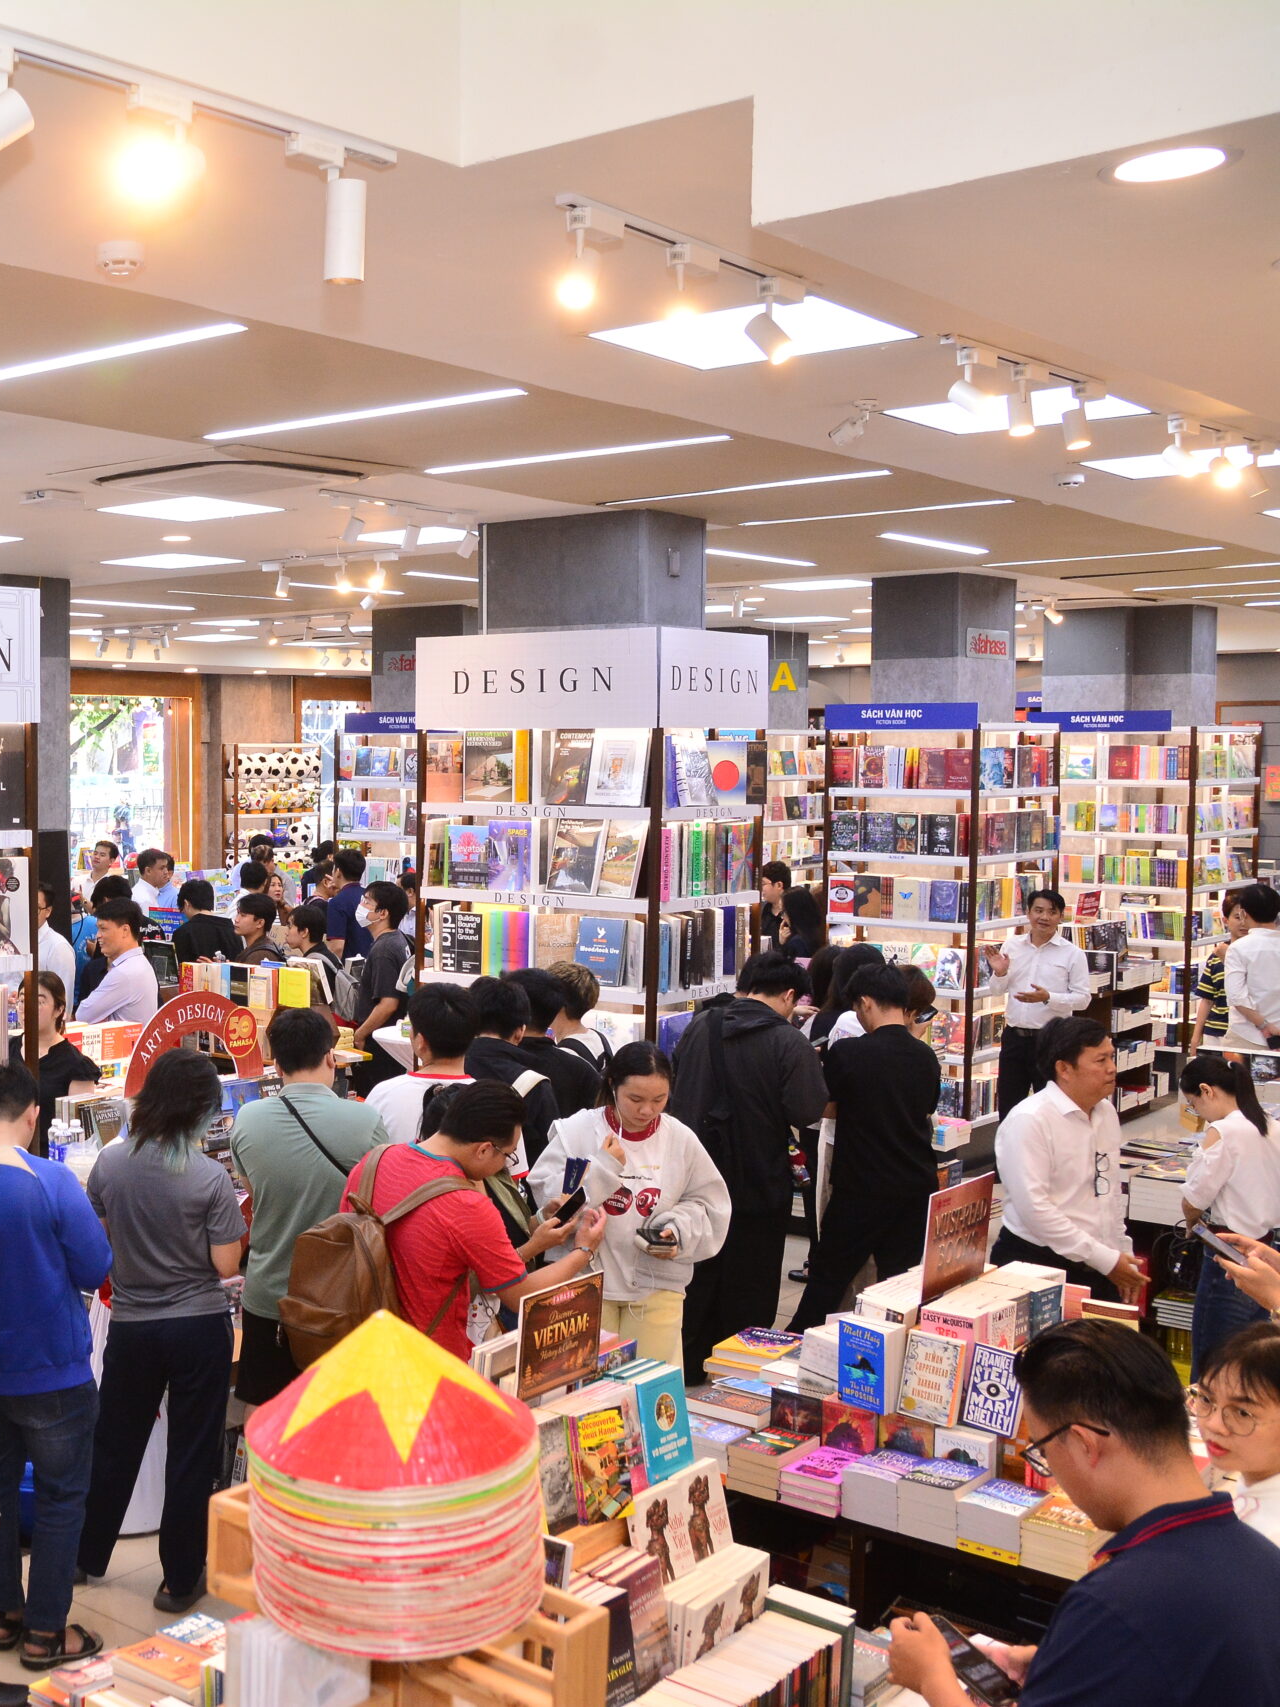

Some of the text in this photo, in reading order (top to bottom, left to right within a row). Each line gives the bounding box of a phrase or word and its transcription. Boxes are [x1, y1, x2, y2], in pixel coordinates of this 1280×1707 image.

[977, 633, 1007, 656] fahasa
[453, 666, 614, 695] DESIGN
[671, 665, 759, 694] DESIGN
[771, 662, 798, 692] A
[379, 716, 408, 724] SÁCH VĂN
[861, 708, 923, 719] SÁCH VĂN HỌC
[1071, 715, 1124, 723] SÁCH VĂN HỌC
[496, 806, 567, 817] DESIGN
[696, 808, 733, 817] DESIGN
[508, 829, 527, 837] SPACE
[494, 893, 565, 907] DESIGN
[694, 897, 730, 908] DESIGN
[458, 915, 481, 923] Building
[692, 985, 729, 999] DESIGN
[140, 1029, 164, 1064] ART
[165, 1018, 175, 1032] &
[177, 1003, 225, 1025] DESIGN
[228, 1015, 254, 1040] 50
[230, 1038, 253, 1049] FAHASA
[922, 1314, 973, 1329] CASEY McQUISTON
[533, 1313, 590, 1350] VIETNAM:
[752, 1330, 794, 1341] IMMUNE
[842, 1323, 881, 1347] Matt Haig
[936, 1327, 958, 1338] RED
[539, 1348, 558, 1362] History
[562, 1341, 579, 1354] Culture
[924, 1352, 943, 1365] DEMON
[915, 1362, 949, 1378] COPPERHEAD
[917, 1378, 941, 1391] BARBARA
[974, 1365, 1017, 1392] STEIN
[850, 1381, 874, 1395] The LIFE
[843, 1387, 880, 1406] IMPOSSIBLE
[911, 1389, 944, 1405] KINGSOLVER
[970, 1391, 1013, 1411] MARY
[581, 1416, 616, 1430] Découverte
[967, 1405, 1011, 1432] SHELLEY
[941, 1437, 984, 1453] PENN COLE
[879, 1451, 918, 1464] FREDRIK
[905, 1474, 960, 1487] WINNERS
[998, 1481, 1037, 1496] FREDRIK
[612, 1650, 631, 1666] General
